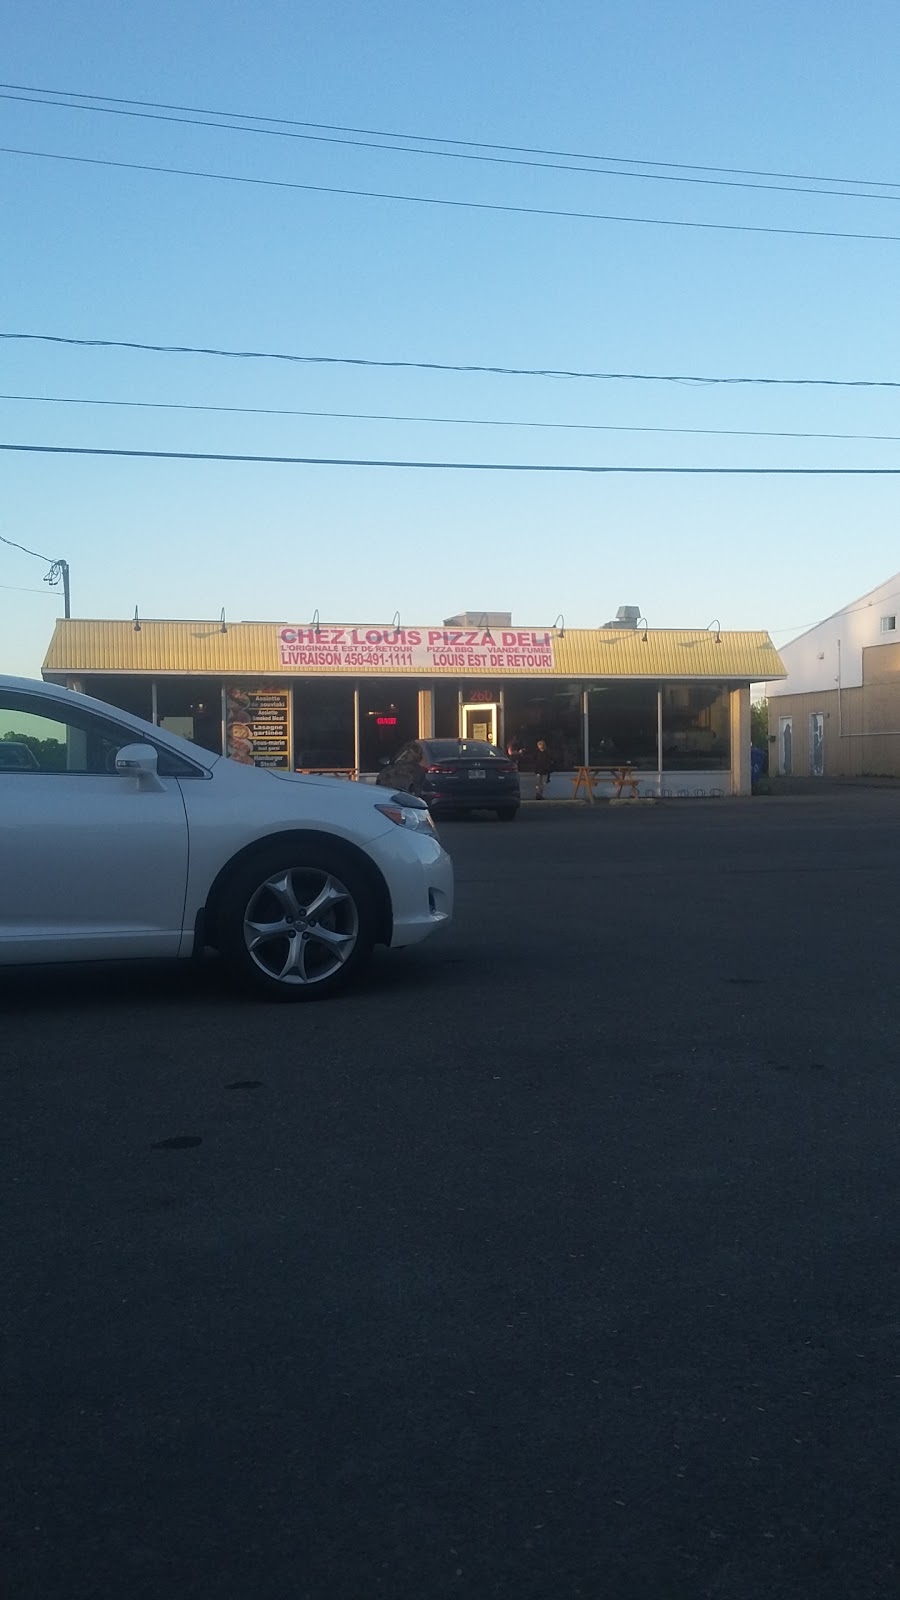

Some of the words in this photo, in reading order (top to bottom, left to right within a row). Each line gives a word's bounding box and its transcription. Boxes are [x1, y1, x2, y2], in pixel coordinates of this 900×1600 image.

[280, 629, 346, 645] CHEZ
[352, 630, 422, 645] LOUIS
[428, 631, 497, 647] PIZZA
[502, 632, 551, 647] DELI
[375, 645, 413, 653] RETOUR
[281, 652, 342, 665] LIVRAISON
[344, 653, 413, 666] 450-491-1111
[433, 653, 465, 666] LOUIS
[469, 654, 487, 667] EST
[490, 655, 505, 667] DE
[507, 655, 552, 667] RETOUR!
[470, 690, 493, 701] 260
